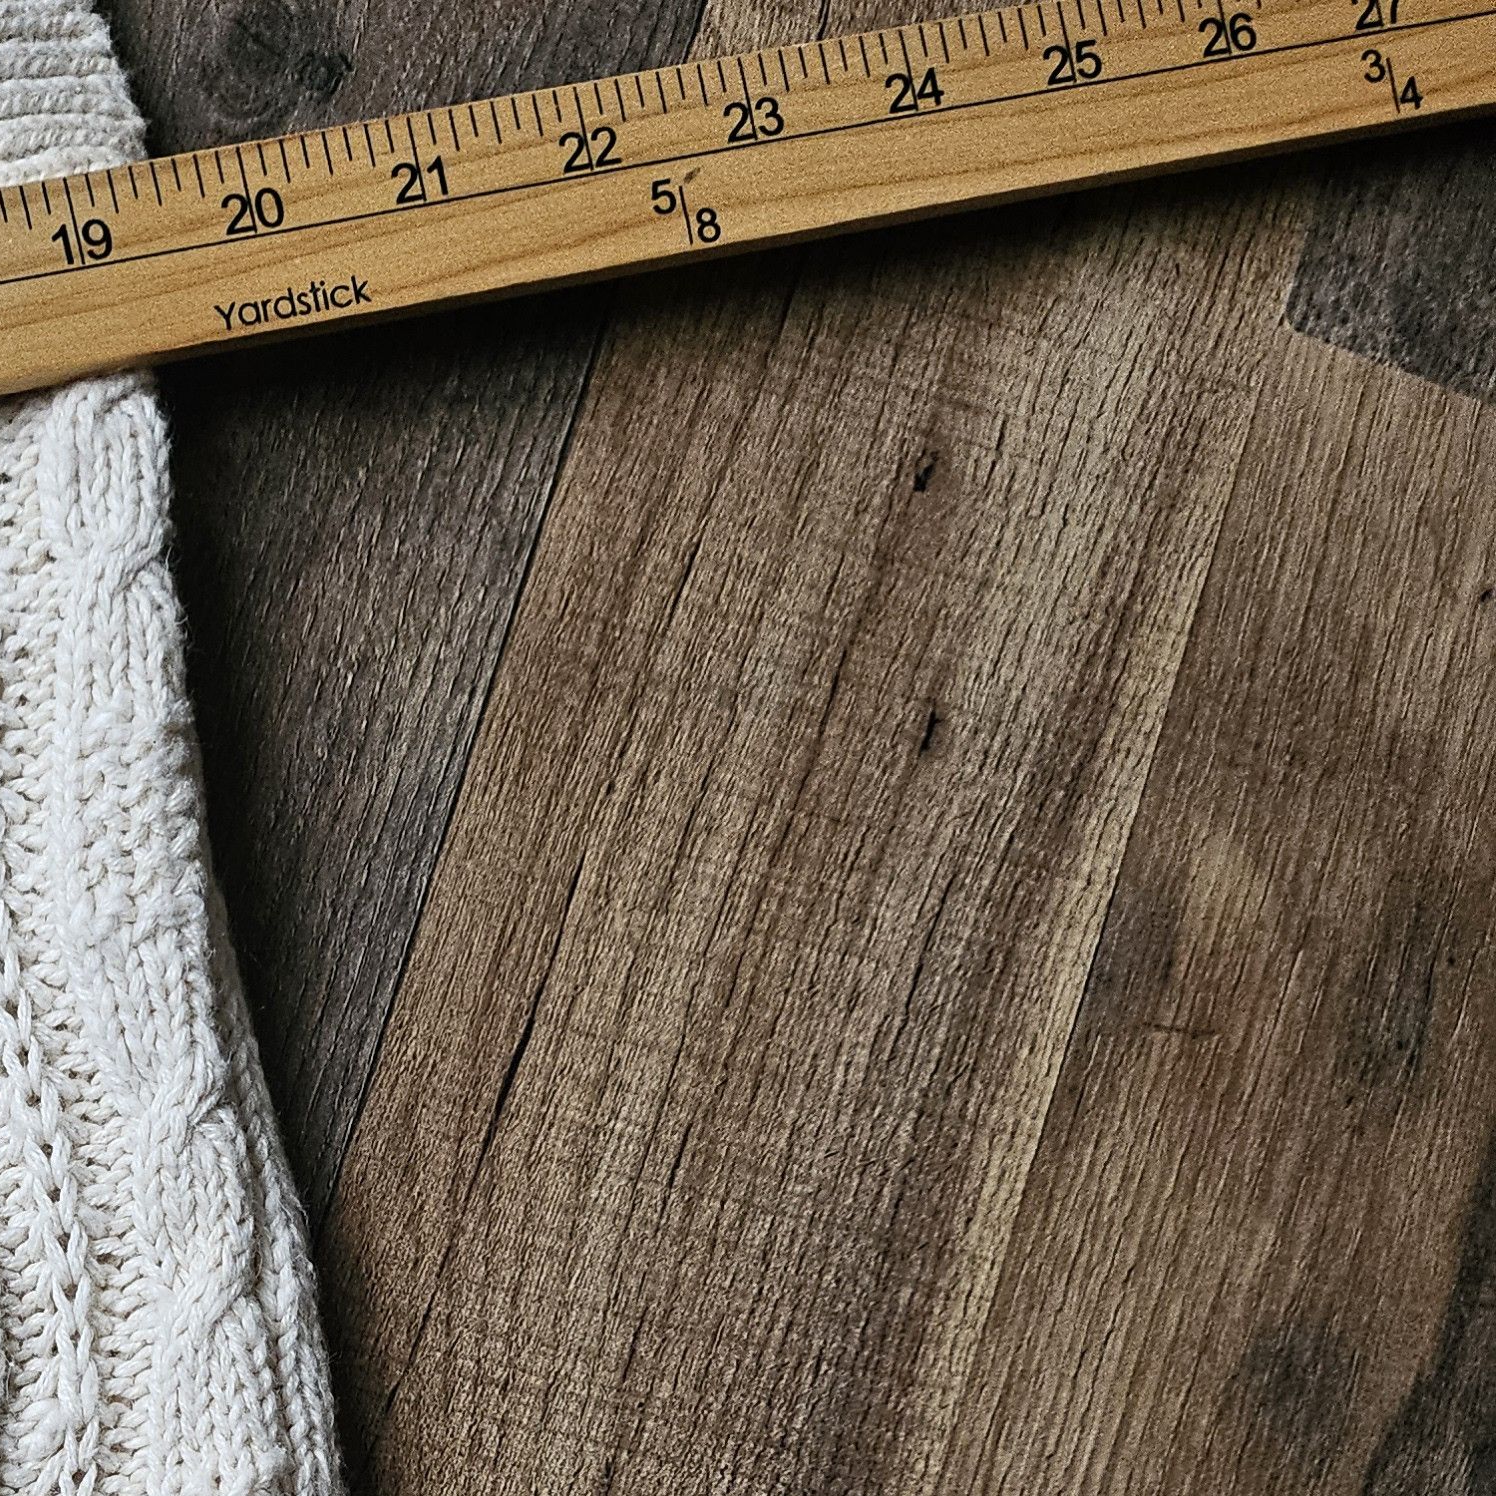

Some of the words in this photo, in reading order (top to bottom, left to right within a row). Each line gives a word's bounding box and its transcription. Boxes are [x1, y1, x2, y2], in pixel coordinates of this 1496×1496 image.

[52, 219, 114, 265] 19
[221, 187, 285, 235] 20
[396, 155, 450, 204] 21
[559, 126, 623, 175] 22
[723, 97, 785, 143] 23
[885, 67, 945, 114] 24
[1042, 48, 1104, 89] 25
[1198, 13, 1257, 58] 26
[213, 275, 372, 331] Yardstick
